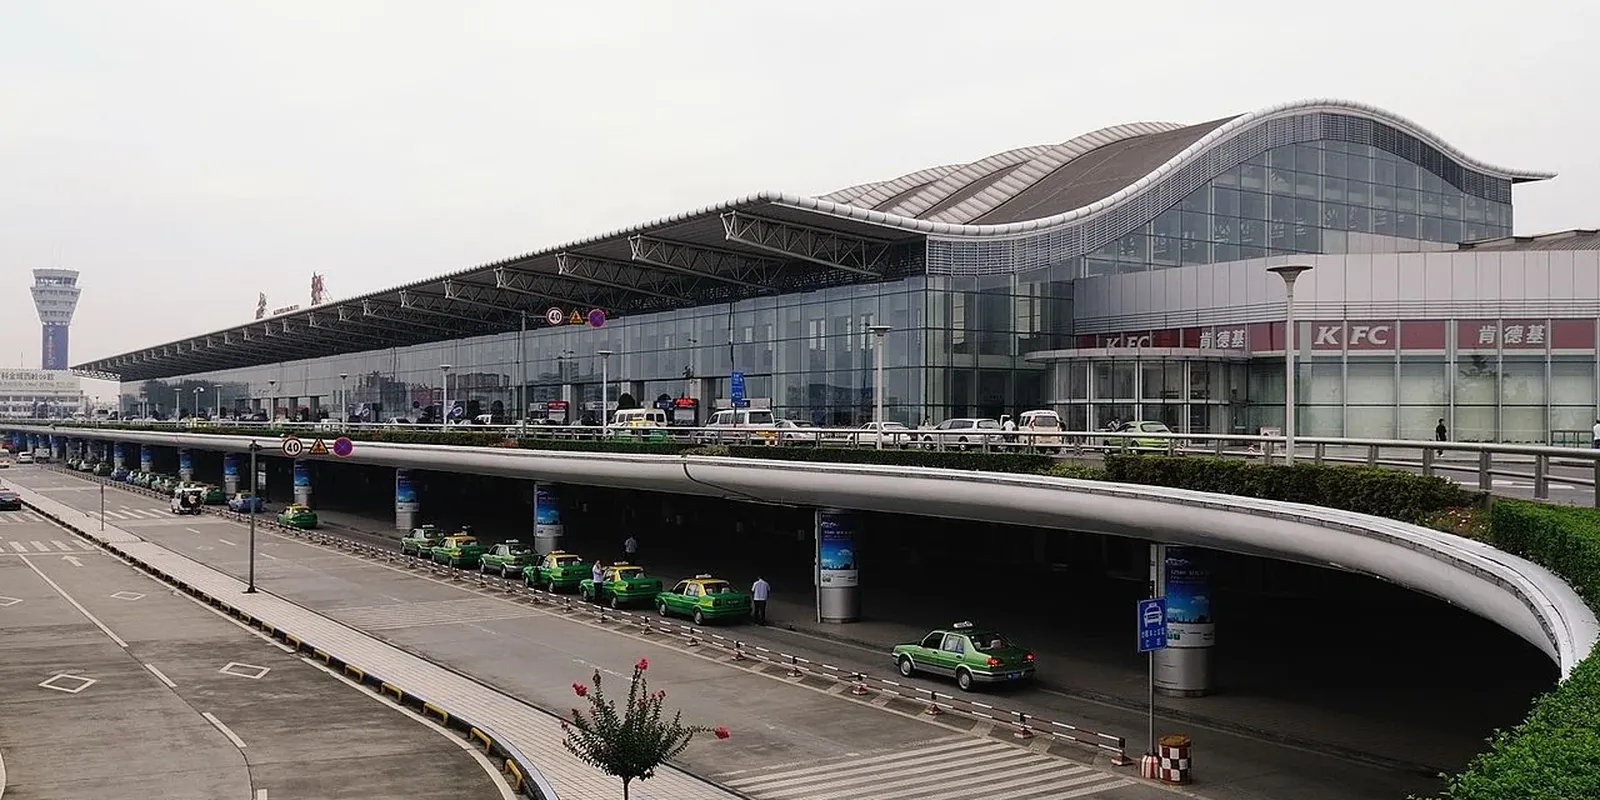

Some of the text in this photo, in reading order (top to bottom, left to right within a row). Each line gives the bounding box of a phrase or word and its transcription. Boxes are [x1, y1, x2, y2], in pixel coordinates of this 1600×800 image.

[549, 311, 561, 322] 40
[1106, 336, 1150, 349] KFC
[1199, 329, 1245, 349] 肯德基
[1313, 326, 1391, 345] KFC
[1478, 325, 1546, 345] 肯德基
[286, 442, 299, 453] 40
